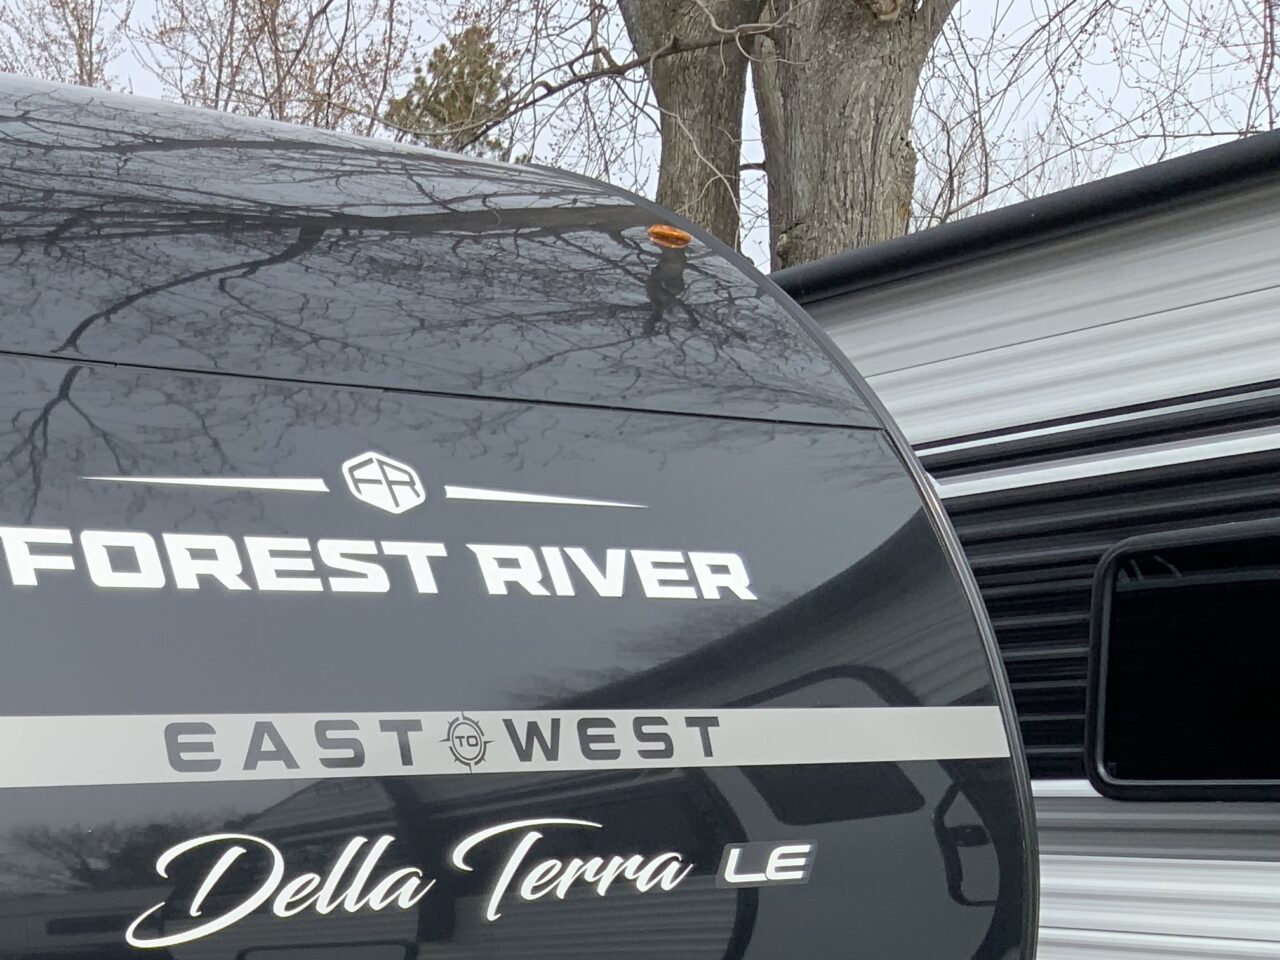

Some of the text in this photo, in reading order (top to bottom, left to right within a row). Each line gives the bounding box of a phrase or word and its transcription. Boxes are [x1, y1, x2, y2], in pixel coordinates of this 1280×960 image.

[465, 542, 761, 601] RIVER
[164, 715, 721, 772] EAST TO WEST
[123, 817, 813, 950] Della Terra LE
